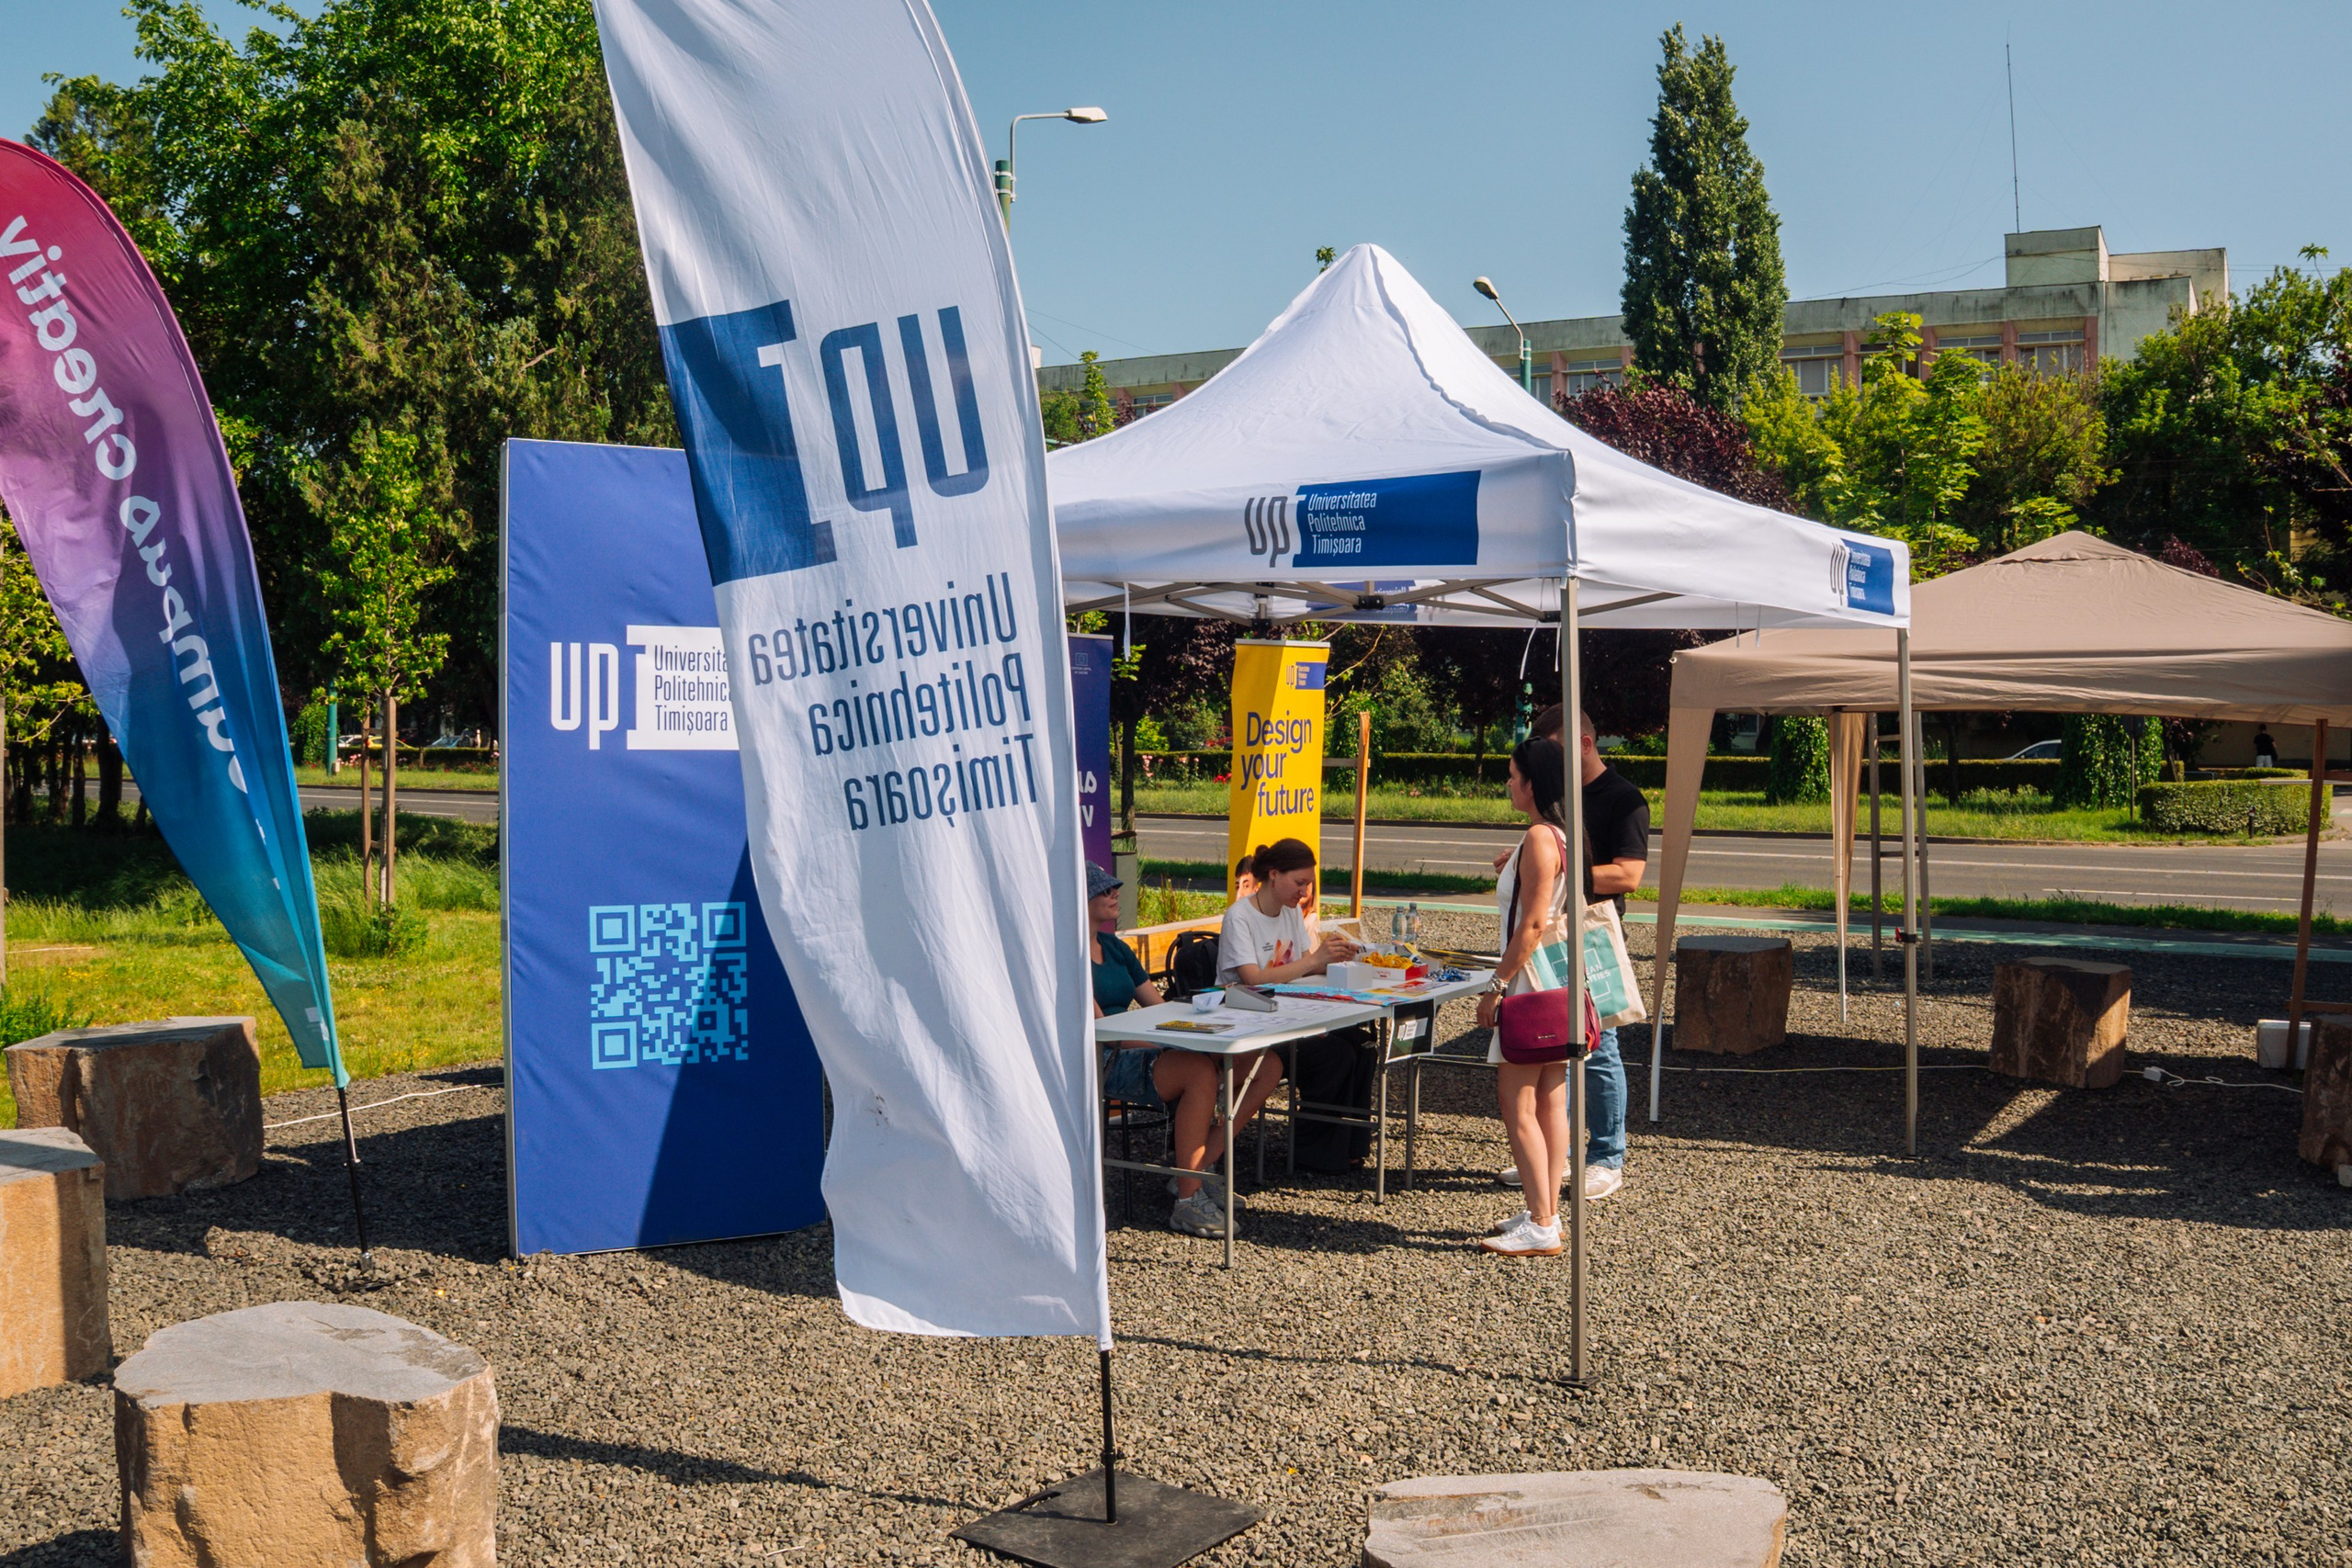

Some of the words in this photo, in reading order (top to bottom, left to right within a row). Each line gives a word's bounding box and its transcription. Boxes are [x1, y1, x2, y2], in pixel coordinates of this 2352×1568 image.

[1307, 491, 1377, 511] Universitatea
[1307, 512, 1366, 532] Politehnica
[1312, 535, 1362, 557] Timișoara
[654, 645, 728, 672] Universita
[655, 674, 731, 702] Politehnic
[655, 705, 728, 736] Timișoara
[1247, 710, 1312, 753] Design
[1240, 752, 1287, 790] your
[1258, 782, 1315, 817] future
